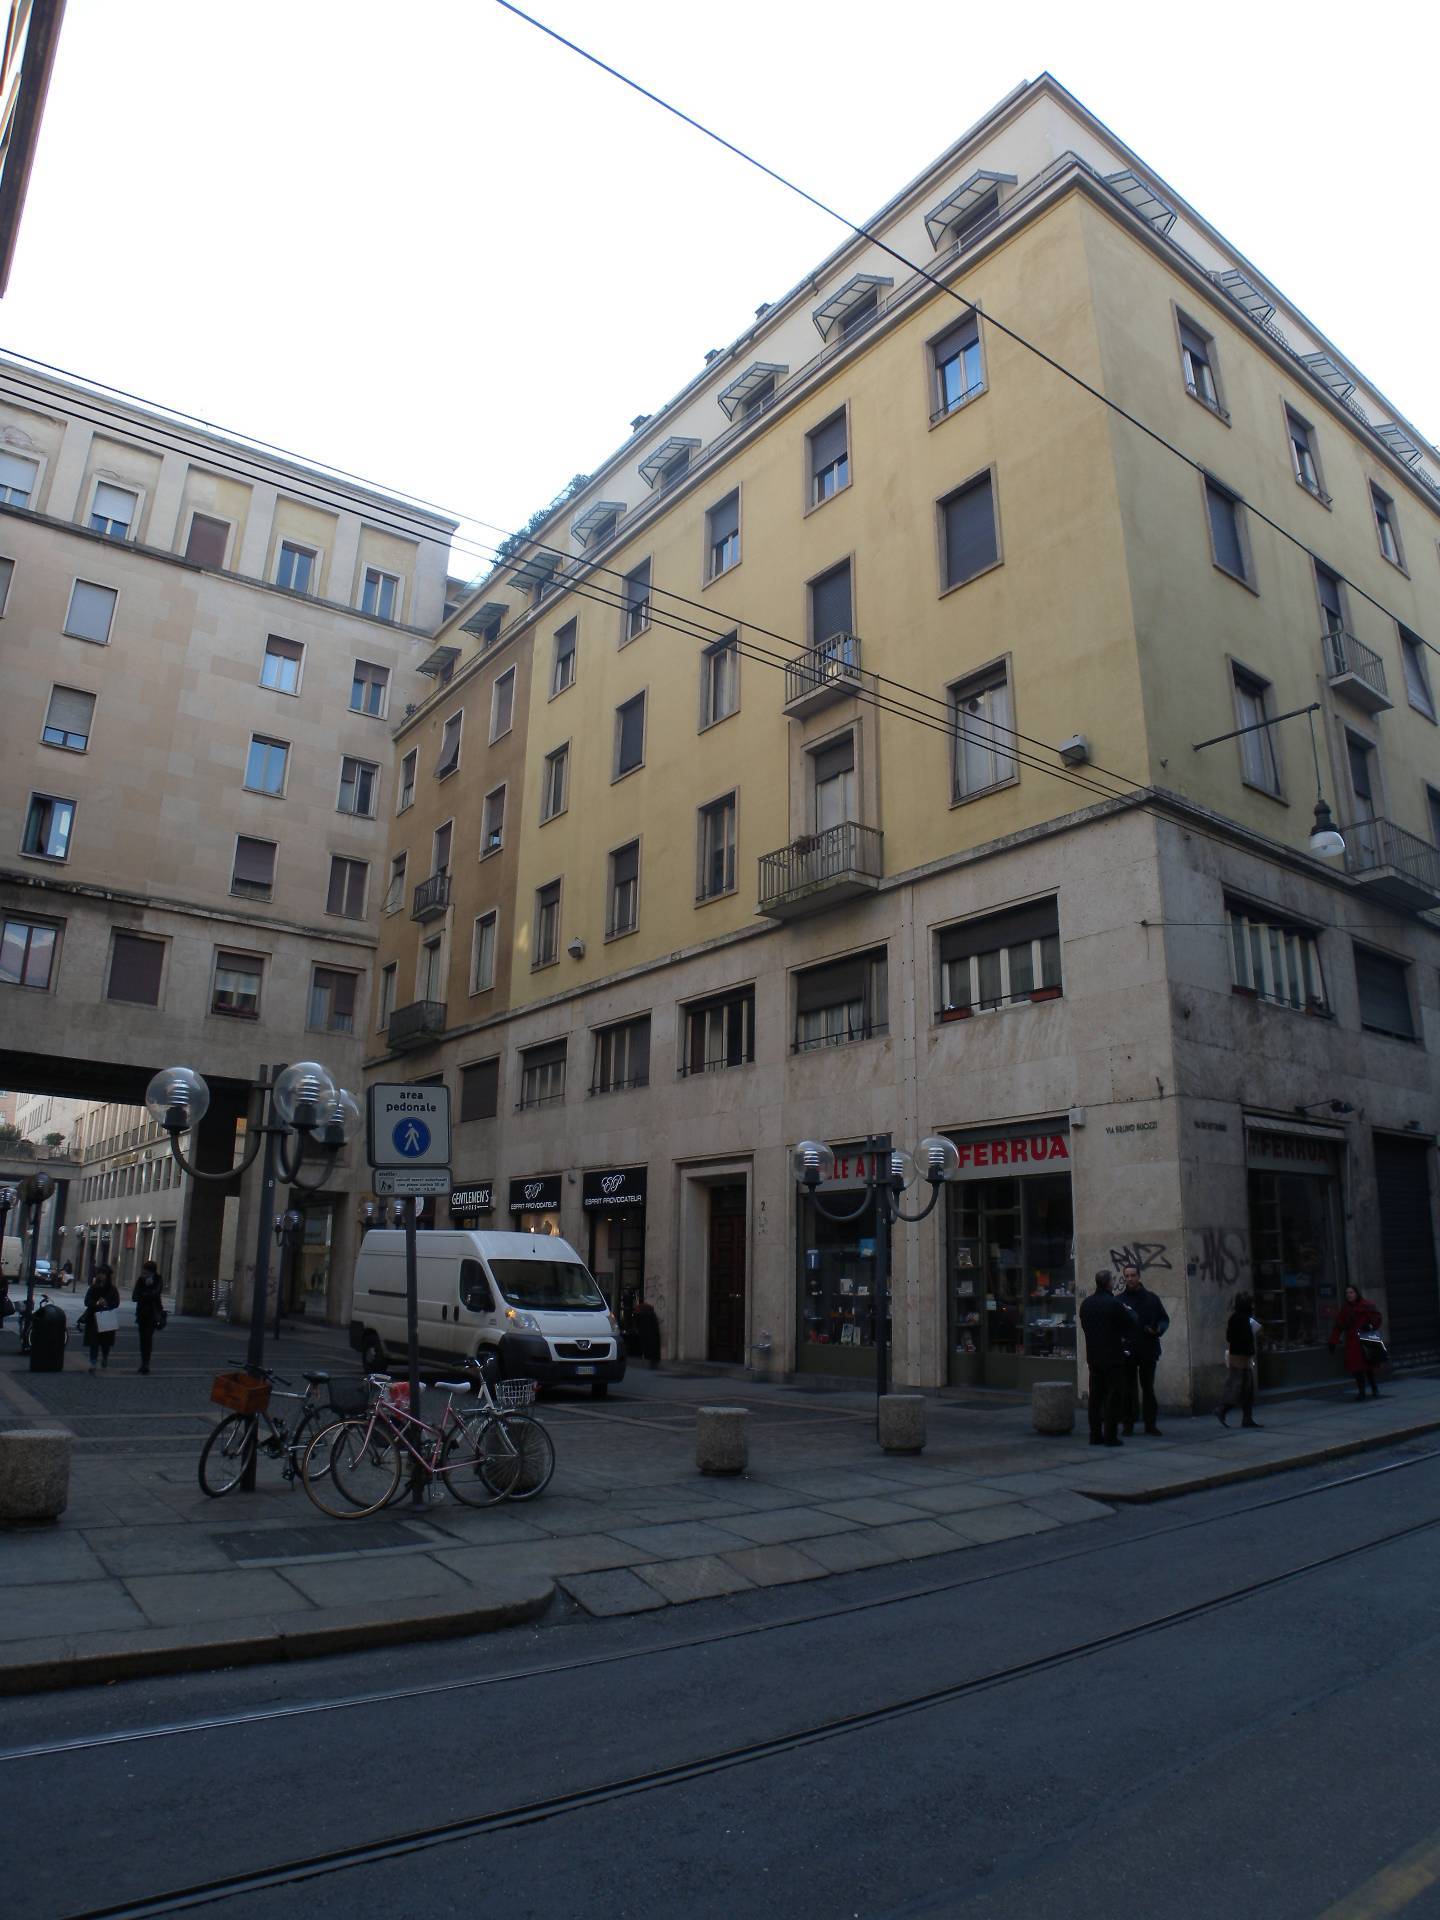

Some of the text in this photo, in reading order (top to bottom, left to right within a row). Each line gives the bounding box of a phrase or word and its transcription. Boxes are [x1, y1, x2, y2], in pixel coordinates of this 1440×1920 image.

[399, 1091, 424, 1100] area
[386, 1102, 437, 1113] pedonale
[1105, 1126, 1115, 1134] VIA
[958, 1135, 1069, 1168] FERRUA
[451, 1189, 490, 1206] GENTLEMEN'S
[584, 1194, 642, 1206] ESPRIT PROVOCATEUR
[510, 1200, 558, 1210] ESPRIT PROVOCATEUR
[760, 1199, 767, 1212] 2
